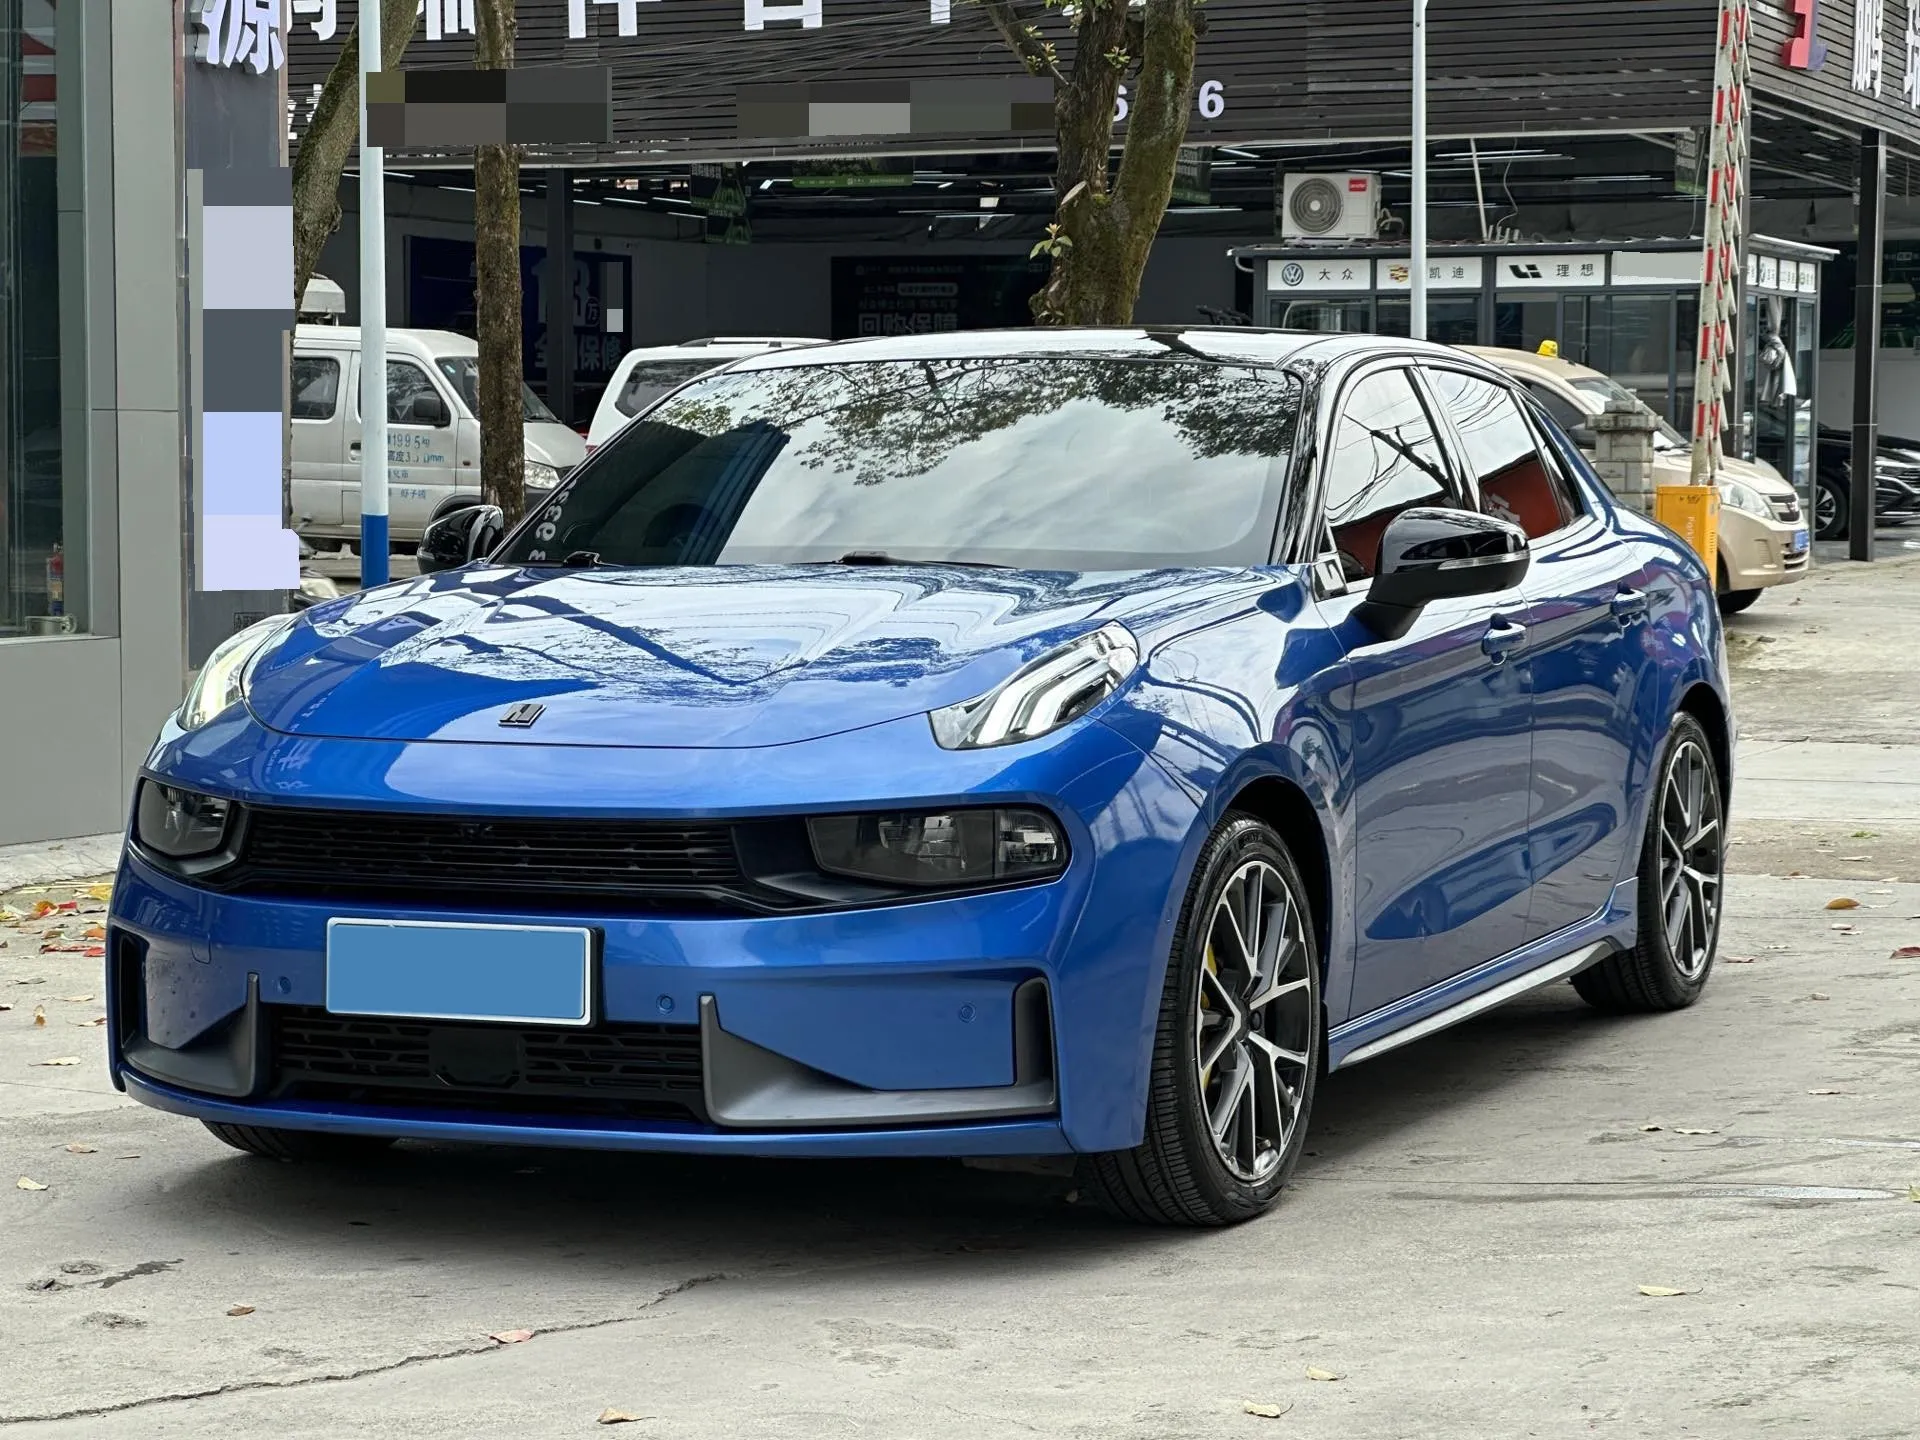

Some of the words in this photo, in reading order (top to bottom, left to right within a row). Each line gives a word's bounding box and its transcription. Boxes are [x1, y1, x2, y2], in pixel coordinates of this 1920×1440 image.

[1199, 80, 1225, 119] 6
[1319, 268, 1354, 282] 大众
[1430, 267, 1465, 280] 凯迪
[1556, 264, 1594, 277] 理想
[534, 332, 622, 372] 全保修
